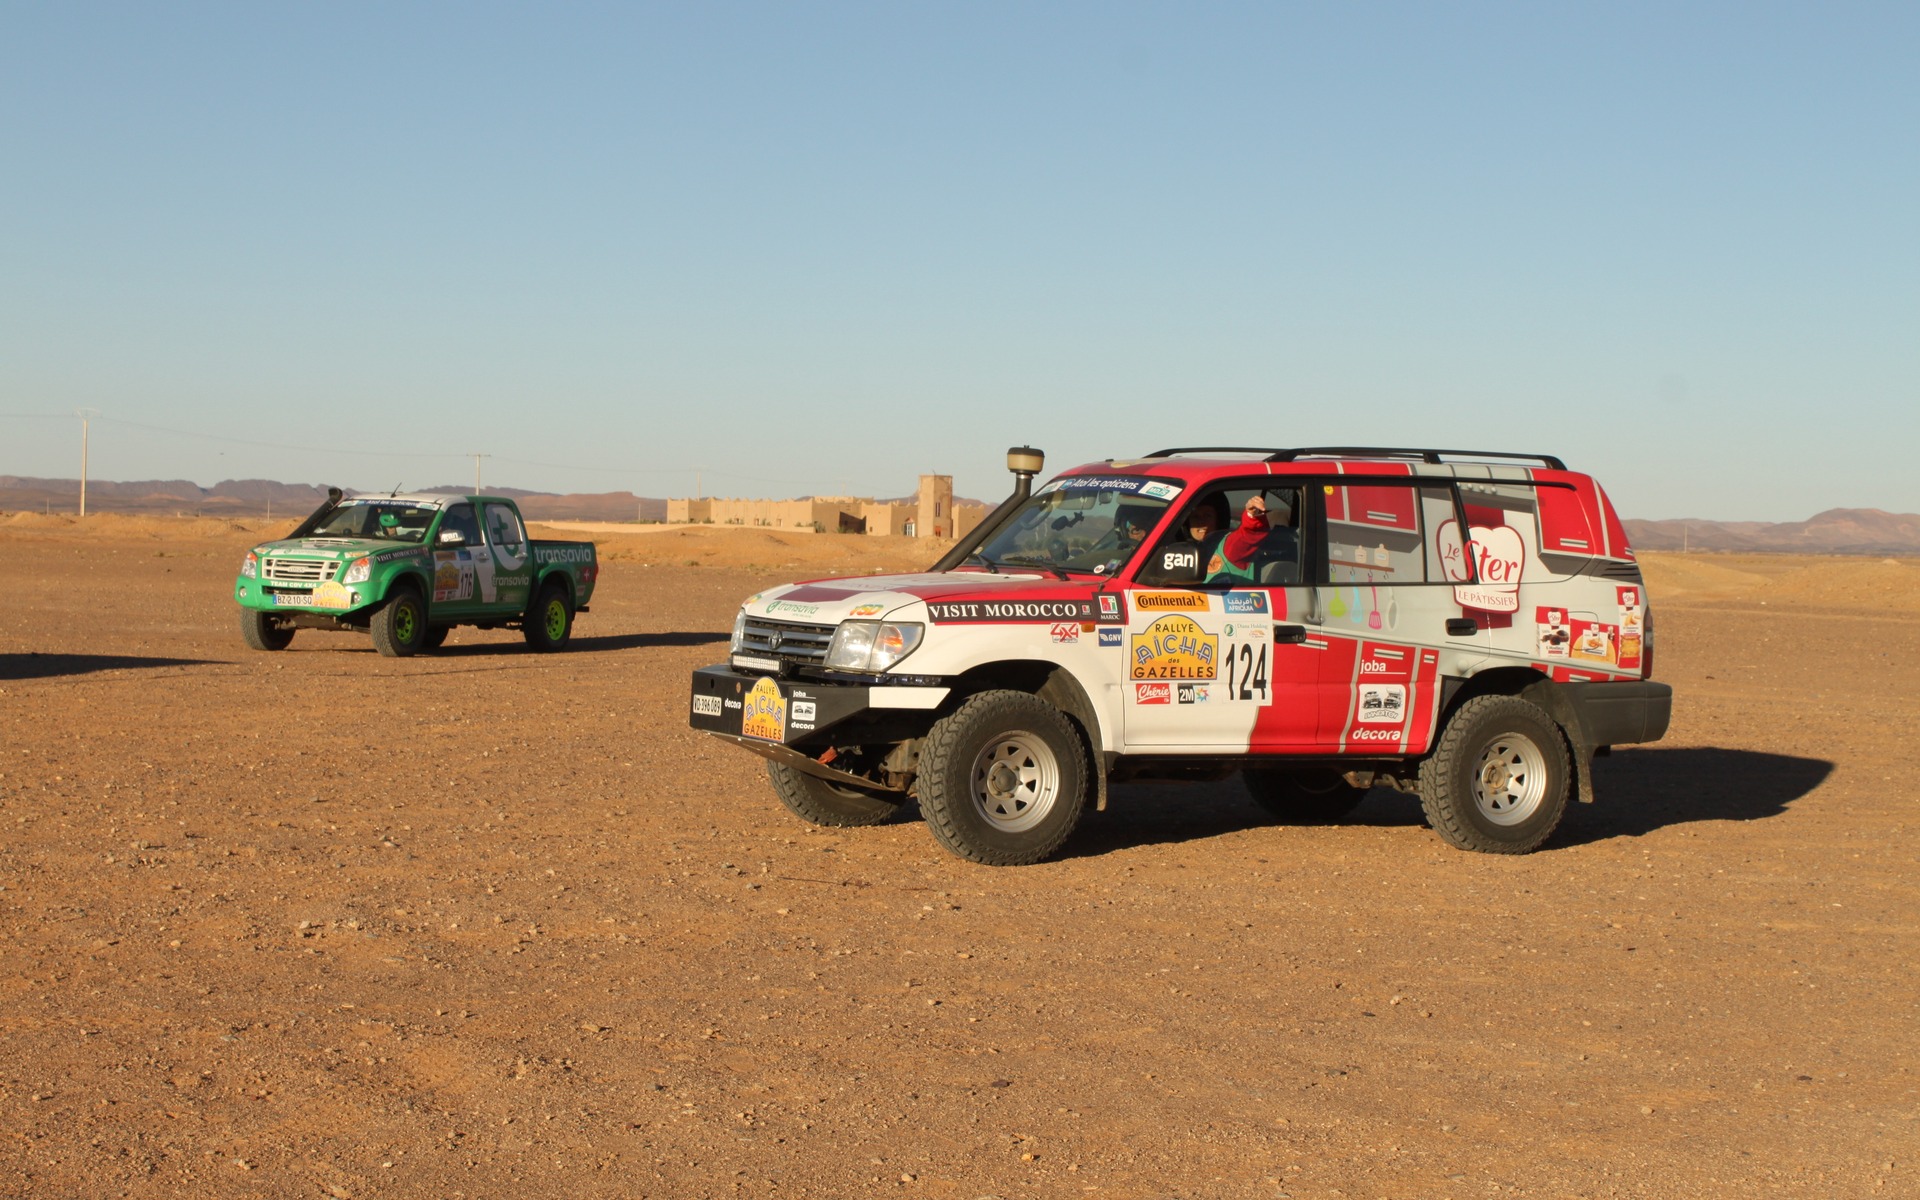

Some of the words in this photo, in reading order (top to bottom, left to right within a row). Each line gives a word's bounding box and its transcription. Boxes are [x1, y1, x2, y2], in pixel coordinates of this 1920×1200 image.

[1071, 479, 1088, 488] Atol
[1089, 479, 1100, 487] les
[1100, 480, 1139, 490] opticiens
[377, 553, 392, 562] VISIT
[393, 549, 418, 558] MOROCCO
[535, 545, 592, 563] transavia
[1444, 543, 1460, 561] Le
[1164, 552, 1194, 570] gan
[1451, 540, 1518, 582] Ster
[460, 573, 473, 598] 176
[492, 574, 530, 587] transavia
[1138, 595, 1196, 608] Continental
[1458, 590, 1469, 600] LE
[778, 601, 819, 614] transavia
[928, 604, 979, 618] VISIT
[985, 603, 1077, 618] MOROCCO
[1155, 623, 1194, 633] RALLYE
[1108, 633, 1122, 642] GNV
[1134, 666, 1214, 679] GAZELLES
[1225, 643, 1267, 700] 124
[1360, 659, 1386, 674] joba
[756, 683, 775, 695] RALLYE
[792, 690, 807, 698] joba
[1138, 684, 1170, 699] Chérie
[1180, 689, 1194, 702] 2M
[724, 697, 742, 709] decora
[743, 723, 783, 740] GAZELLES
[791, 721, 815, 730] decora
[1352, 728, 1401, 740] decora
